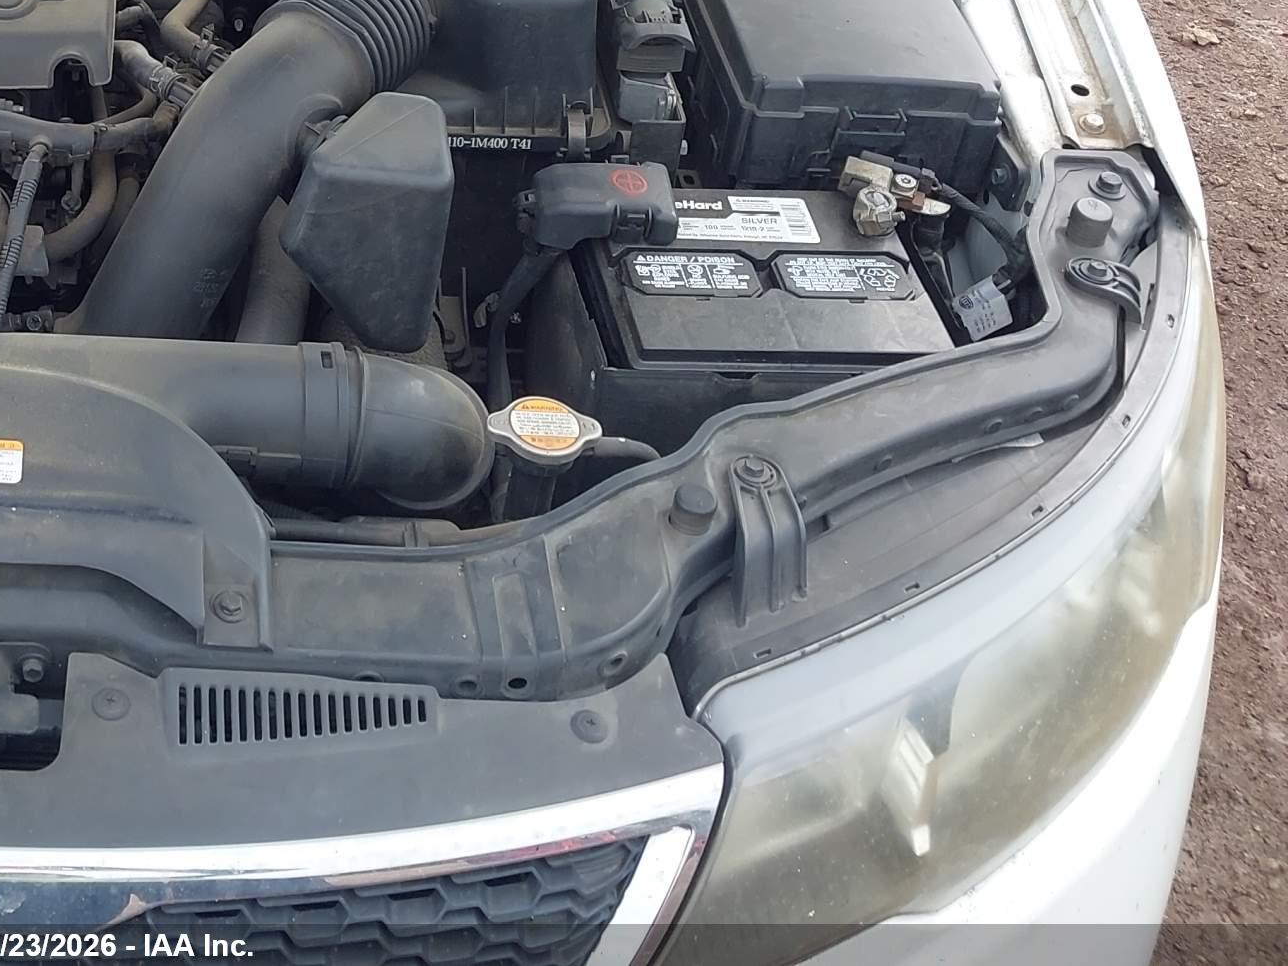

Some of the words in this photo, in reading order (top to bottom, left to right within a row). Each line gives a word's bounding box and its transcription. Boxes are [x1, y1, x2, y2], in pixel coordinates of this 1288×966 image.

[510, 138, 532, 150] T41
[741, 217, 778, 225] SILVER
[646, 255, 688, 263] DANGER
[697, 256, 735, 264] POISON
